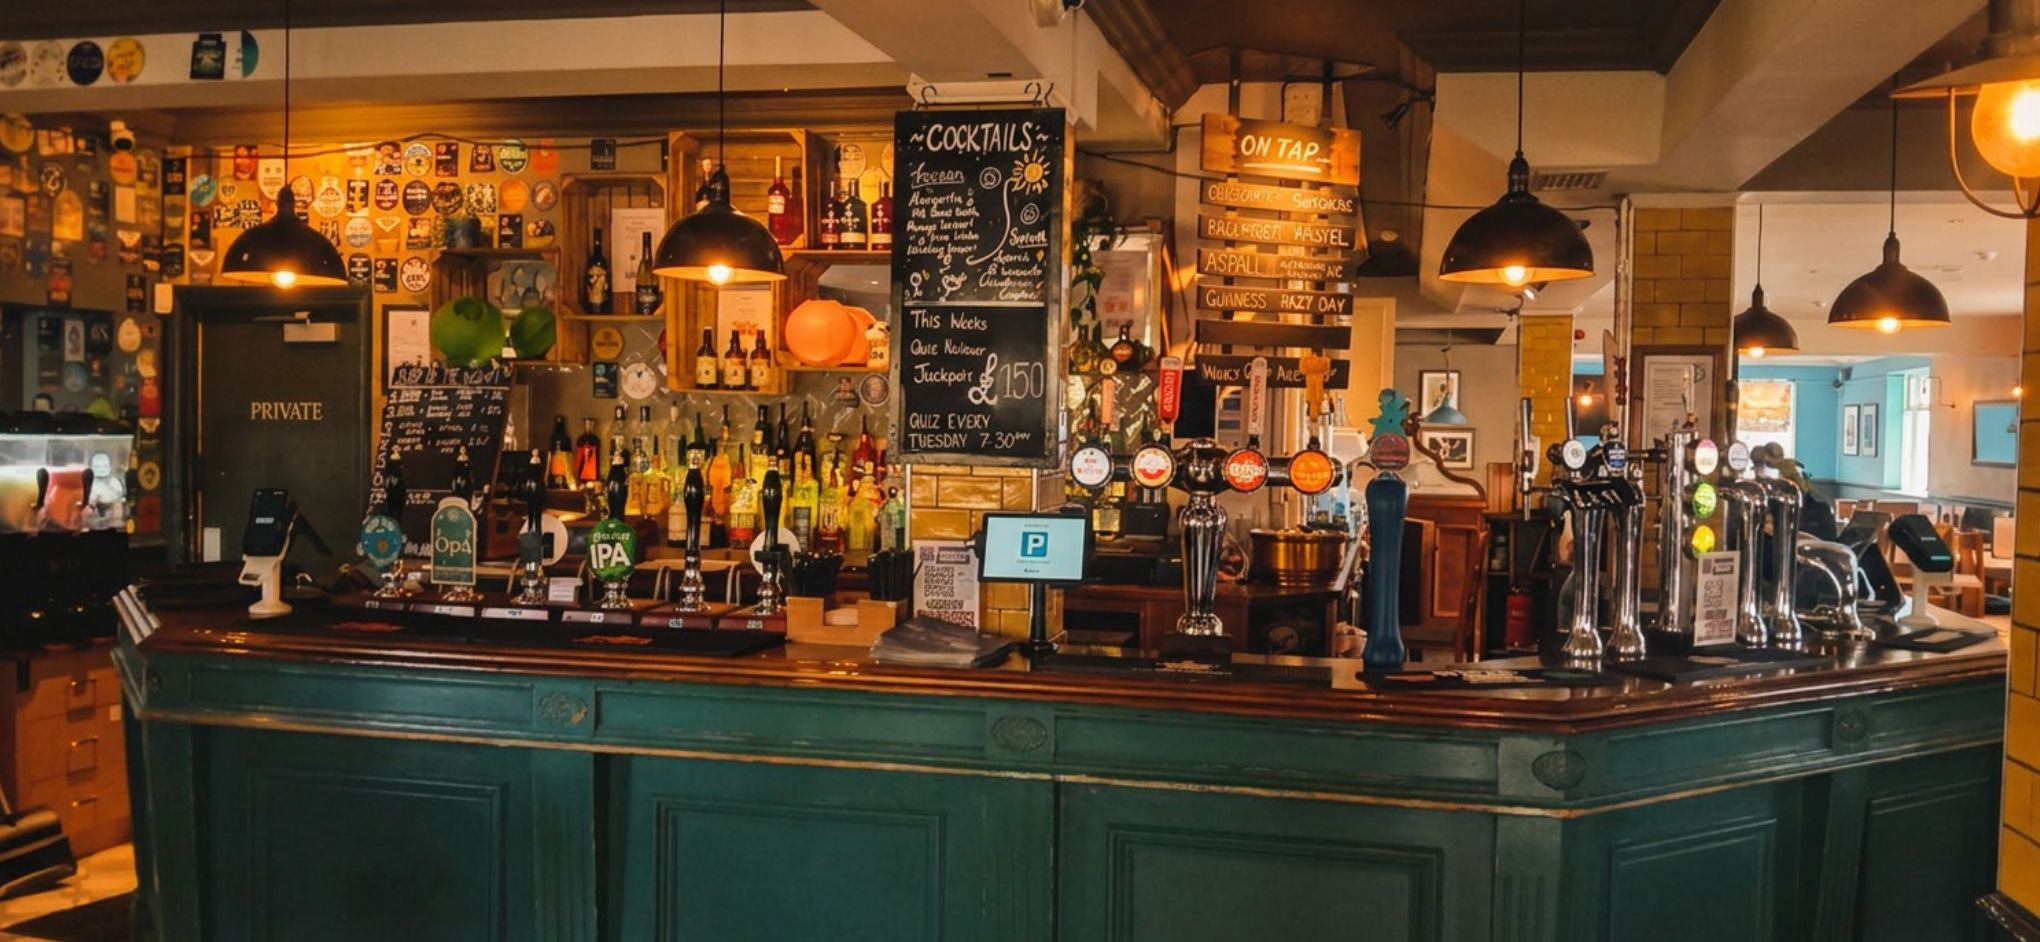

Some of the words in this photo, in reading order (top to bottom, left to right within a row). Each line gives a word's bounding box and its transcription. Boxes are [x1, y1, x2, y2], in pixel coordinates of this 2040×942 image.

[925, 121, 1033, 153] COCKTAILS
[1240, 134, 1272, 157] ON
[1204, 252, 1260, 275] ASPALL
[1318, 297, 1346, 313] DAY
[910, 309, 941, 329] This
[951, 312, 988, 331] Weeks
[251, 401, 324, 421] PRIVATE
[909, 412, 940, 430] QUIZ
[948, 413, 991, 430] EVERY
[908, 433, 968, 448] TUESDAY
[590, 542, 631, 569] IPA
